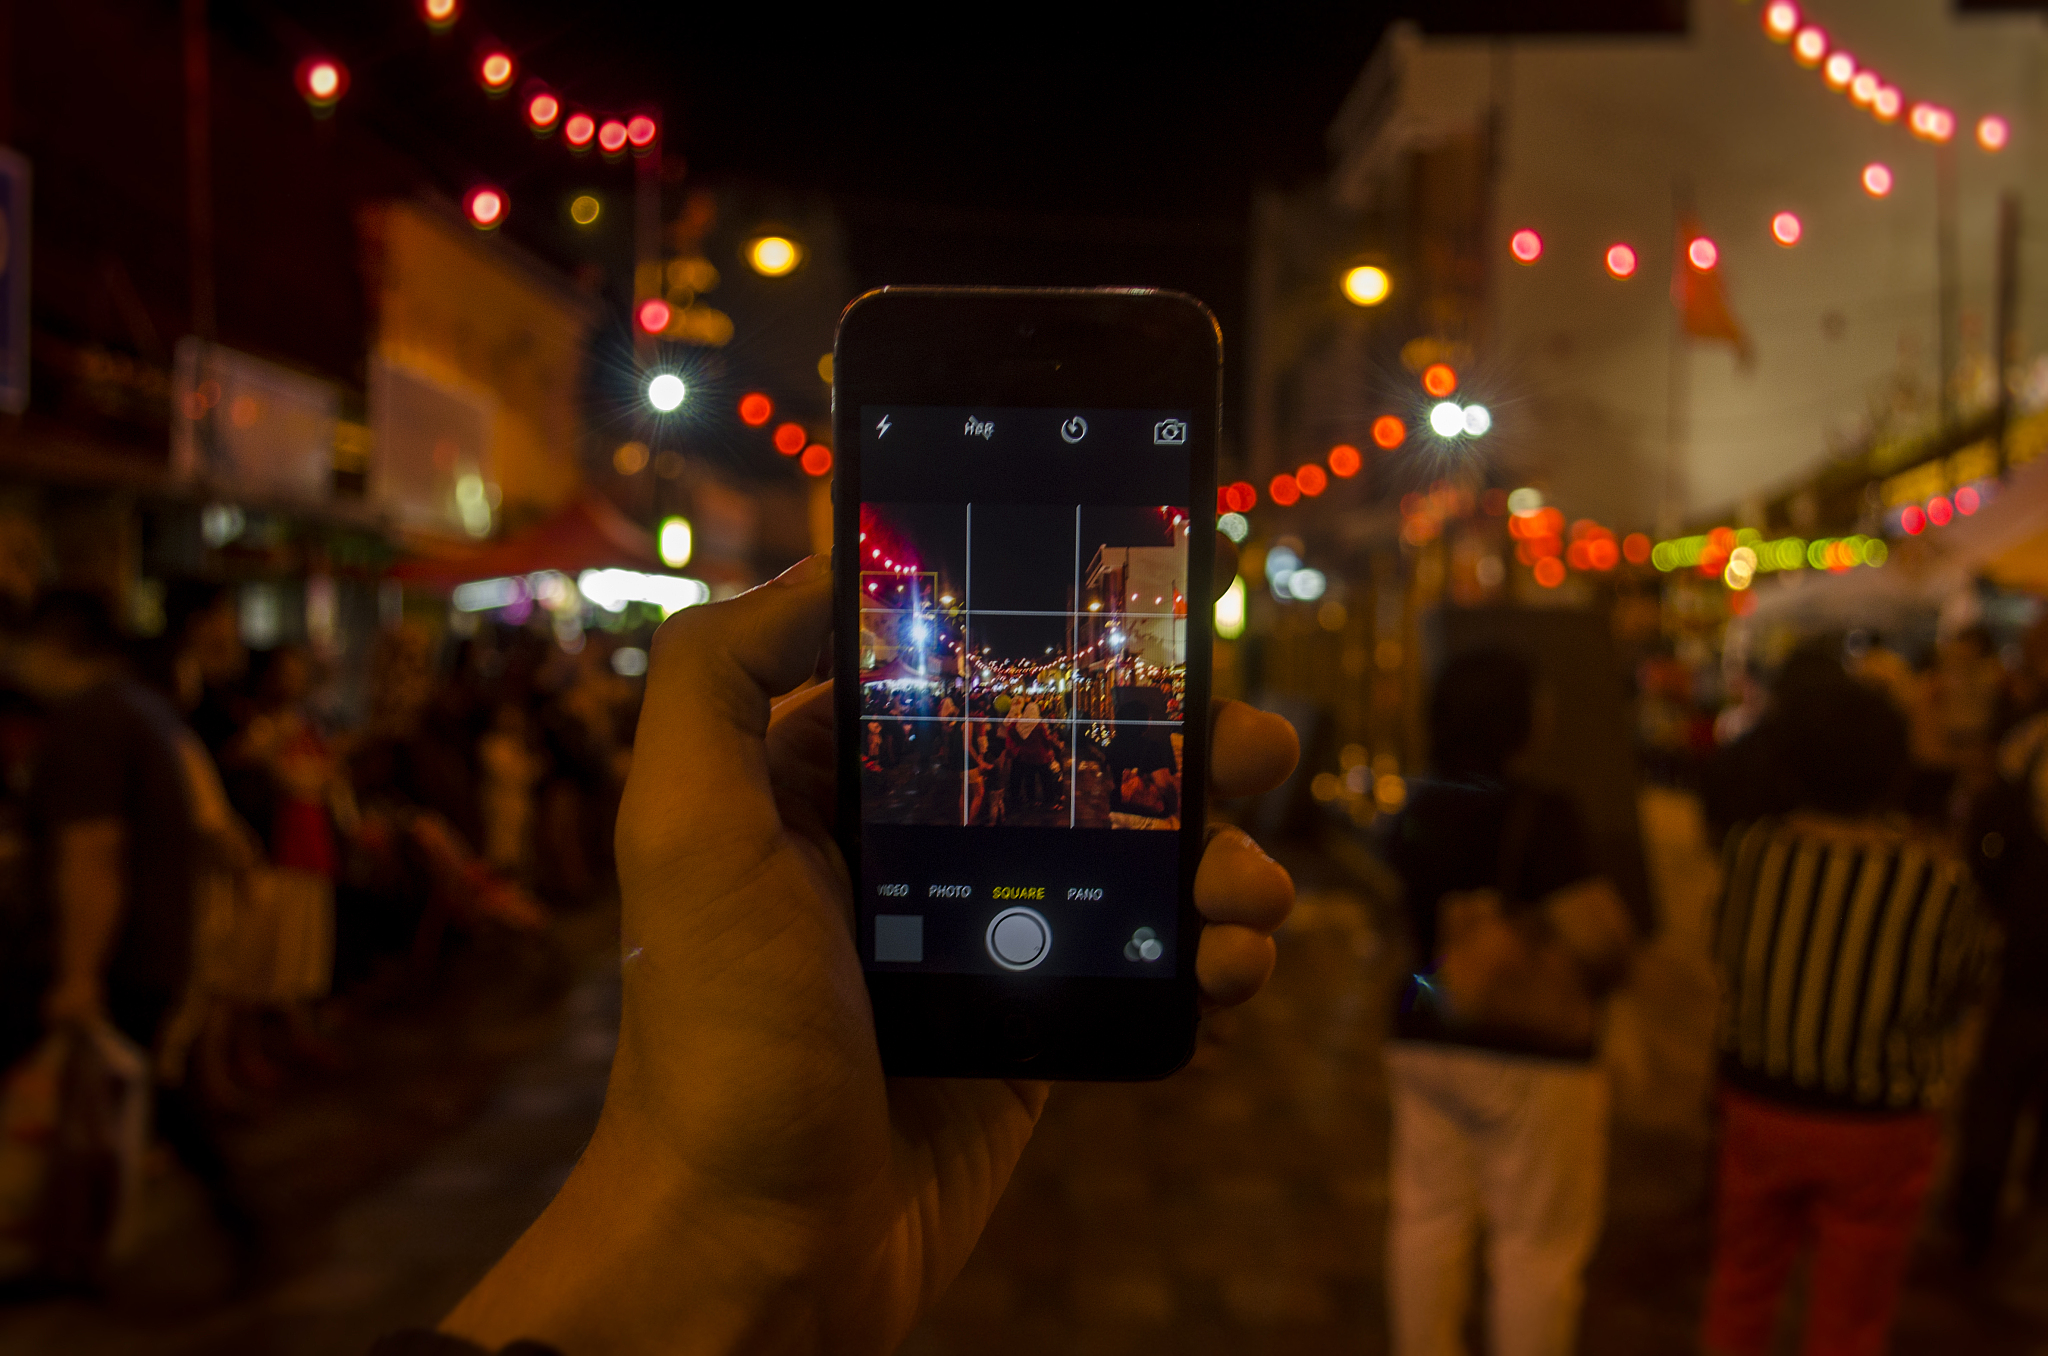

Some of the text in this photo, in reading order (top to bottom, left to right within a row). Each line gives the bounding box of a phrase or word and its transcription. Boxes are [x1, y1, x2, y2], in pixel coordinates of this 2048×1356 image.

[964, 420, 995, 437] HDR
[877, 883, 1104, 901] VIDEO PHOTO SQUARE PANO
